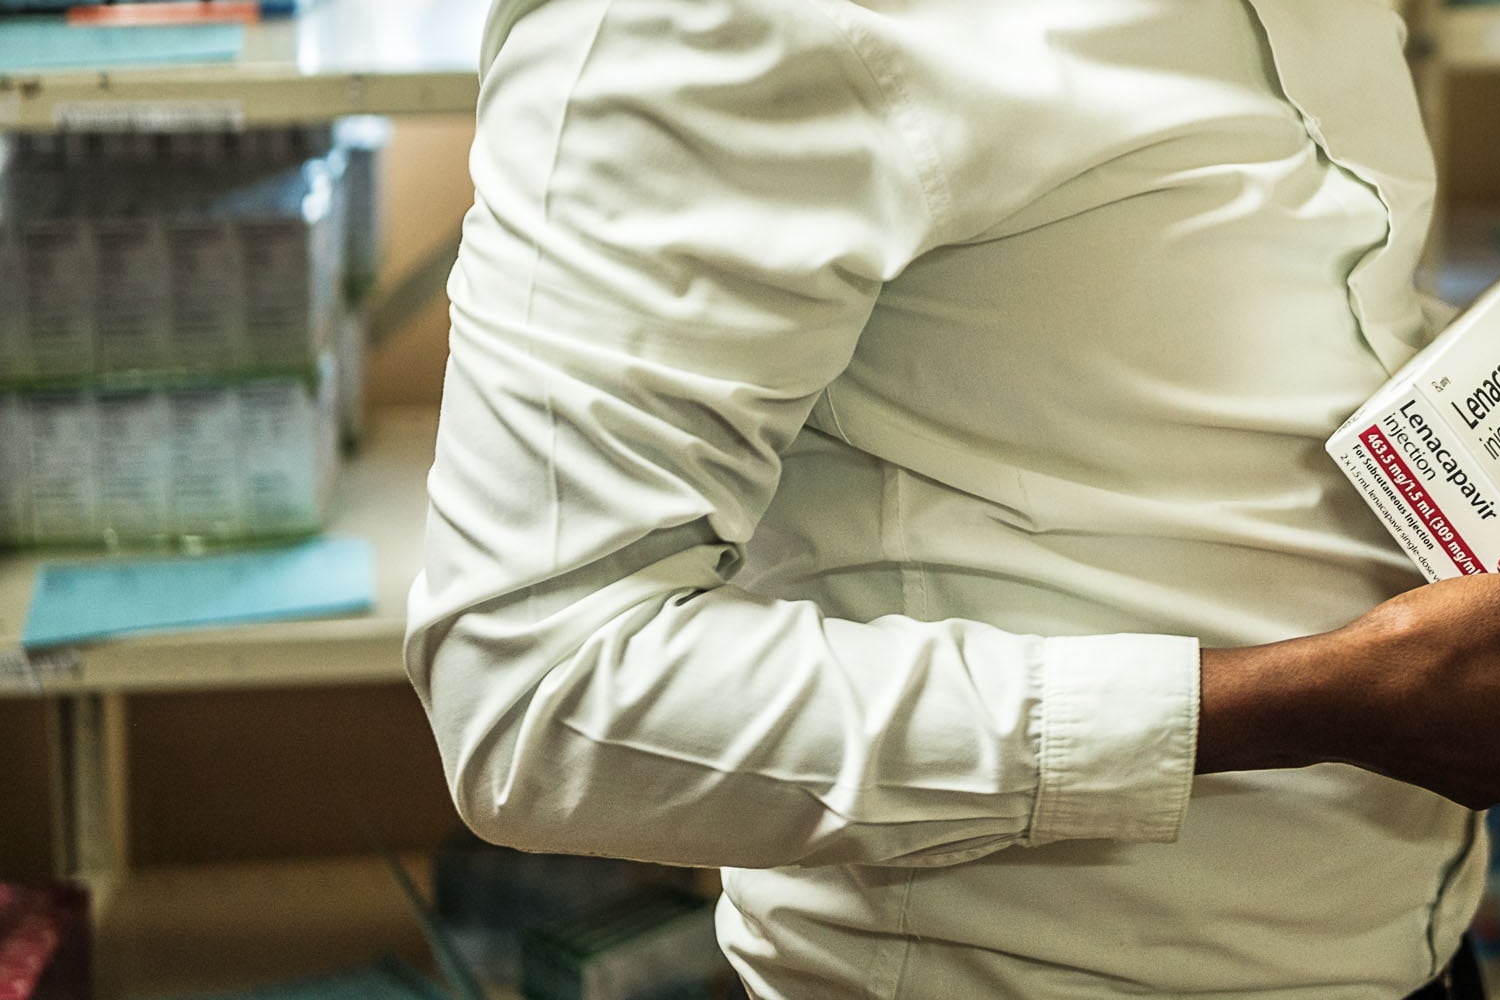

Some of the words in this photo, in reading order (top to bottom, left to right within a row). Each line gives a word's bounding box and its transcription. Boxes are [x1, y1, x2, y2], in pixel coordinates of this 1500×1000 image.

[1353, 443, 1364, 458] For
[1363, 457, 1407, 515] Subcutaneous
[1404, 514, 1435, 550] Injection
[1368, 434, 1395, 464] 463.5
[1389, 460, 1423, 501] mg/1.5
[1417, 500, 1435, 520] mL
[1430, 516, 1454, 542] (309
[1383, 412, 1436, 481] injection
[1400, 400, 1496, 520] Lenacapavir
[1358, 476, 1369, 492] mL
[1368, 490, 1402, 533] lenacapavir
[1400, 532, 1436, 576] single-dose
